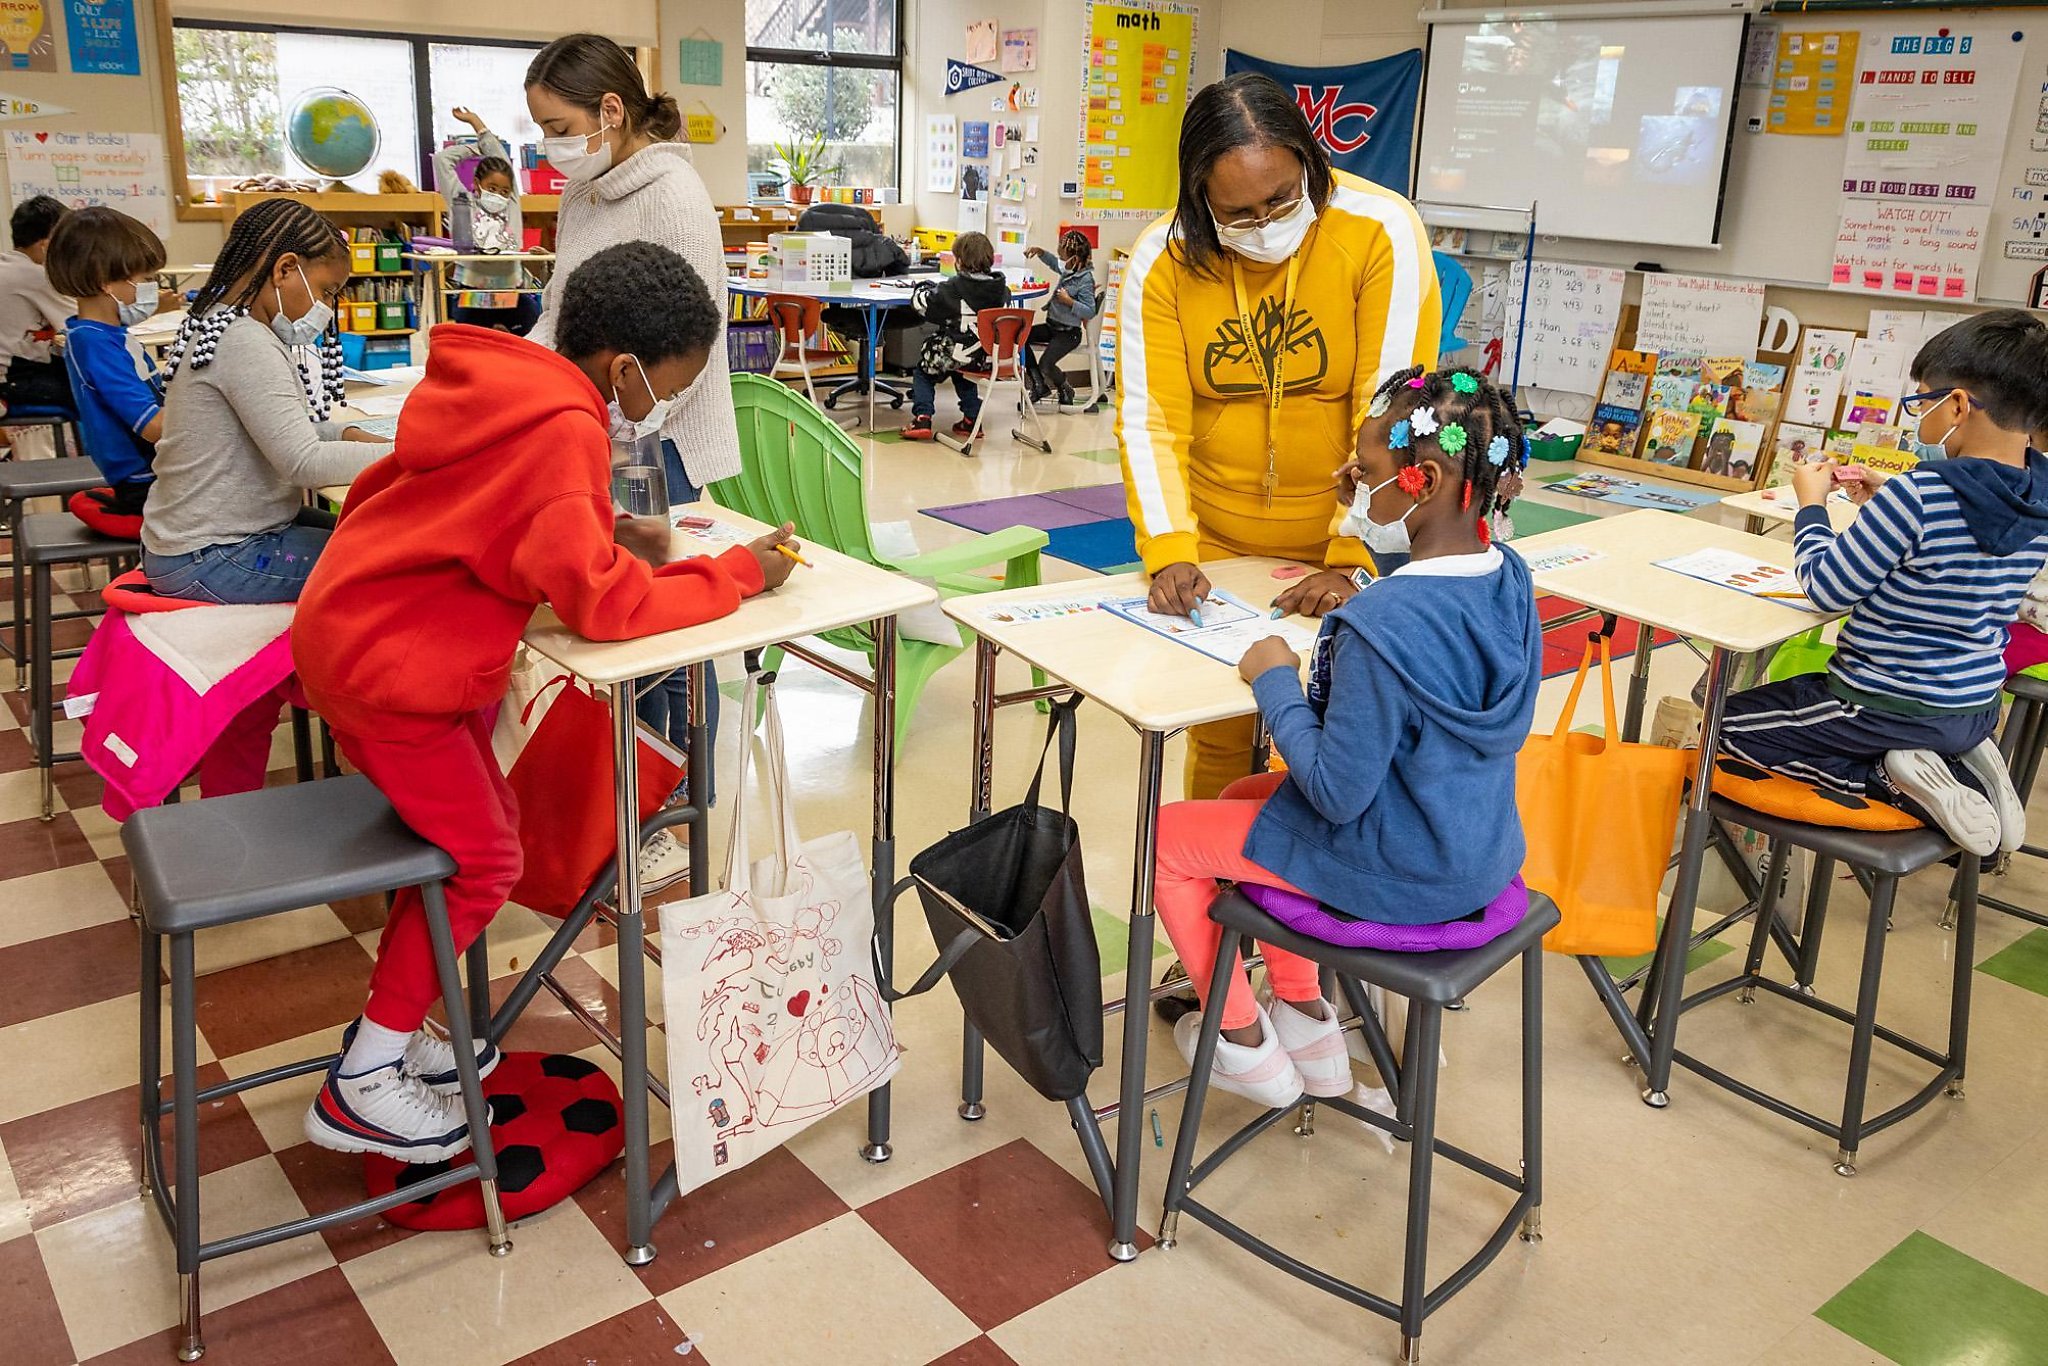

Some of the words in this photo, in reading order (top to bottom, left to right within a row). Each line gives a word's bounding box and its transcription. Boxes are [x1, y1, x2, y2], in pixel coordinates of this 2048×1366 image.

[74, 2, 101, 16] ONLY
[1117, 12, 1160, 31] math
[94, 29, 121, 39] LIVE
[1892, 39, 1920, 53] THE
[1925, 39, 1953, 53] BIG
[1960, 38, 1971, 53] 3
[1879, 71, 1915, 83] HANDS
[1922, 71, 1937, 83] TO
[1944, 71, 1975, 83] SELF
[1870, 122, 1895, 132] SHOW
[1900, 122, 1950, 134] KINDNESS
[1956, 124, 1976, 135] AND
[11, 132, 30, 143] We
[55, 132, 80, 145] Our
[87, 132, 130, 147] Books!
[1867, 140, 1909, 151] RESPECT
[16, 146, 46, 162] Turn
[51, 153, 87, 166] pages
[58, 183, 90, 196] books
[1861, 181, 1875, 192] BE
[1881, 182, 1906, 194] YOUR
[1910, 184, 1938, 196] BEST
[1945, 185, 1975, 199] SELF
[2012, 187, 2033, 201] Fun
[1878, 207, 1916, 222] WATCH
[1919, 210, 1952, 223] OUT!
[1844, 218, 1896, 233] Sometimes
[1903, 224, 1933, 236] vowel
[1966, 226, 1979, 238] do
[1838, 231, 1857, 241] not
[1919, 237, 1941, 252] long
[1947, 240, 1978, 251] sound
[1513, 264, 1552, 276] Grater
[1555, 265, 1576, 277] than
[1835, 253, 1866, 266] Watch
[1871, 257, 1887, 268] out
[1892, 258, 1907, 270] for
[1912, 262, 1941, 273] words
[1946, 262, 1964, 275] like
[1539, 317, 1561, 333] than
[1760, 305, 1800, 354] D
[1617, 380, 1641, 391] Night
[1621, 389, 1635, 398] Job
[1597, 410, 1613, 421] YOU
[1867, 456, 1904, 472] School
[358, 1081, 382, 1095] FILA
